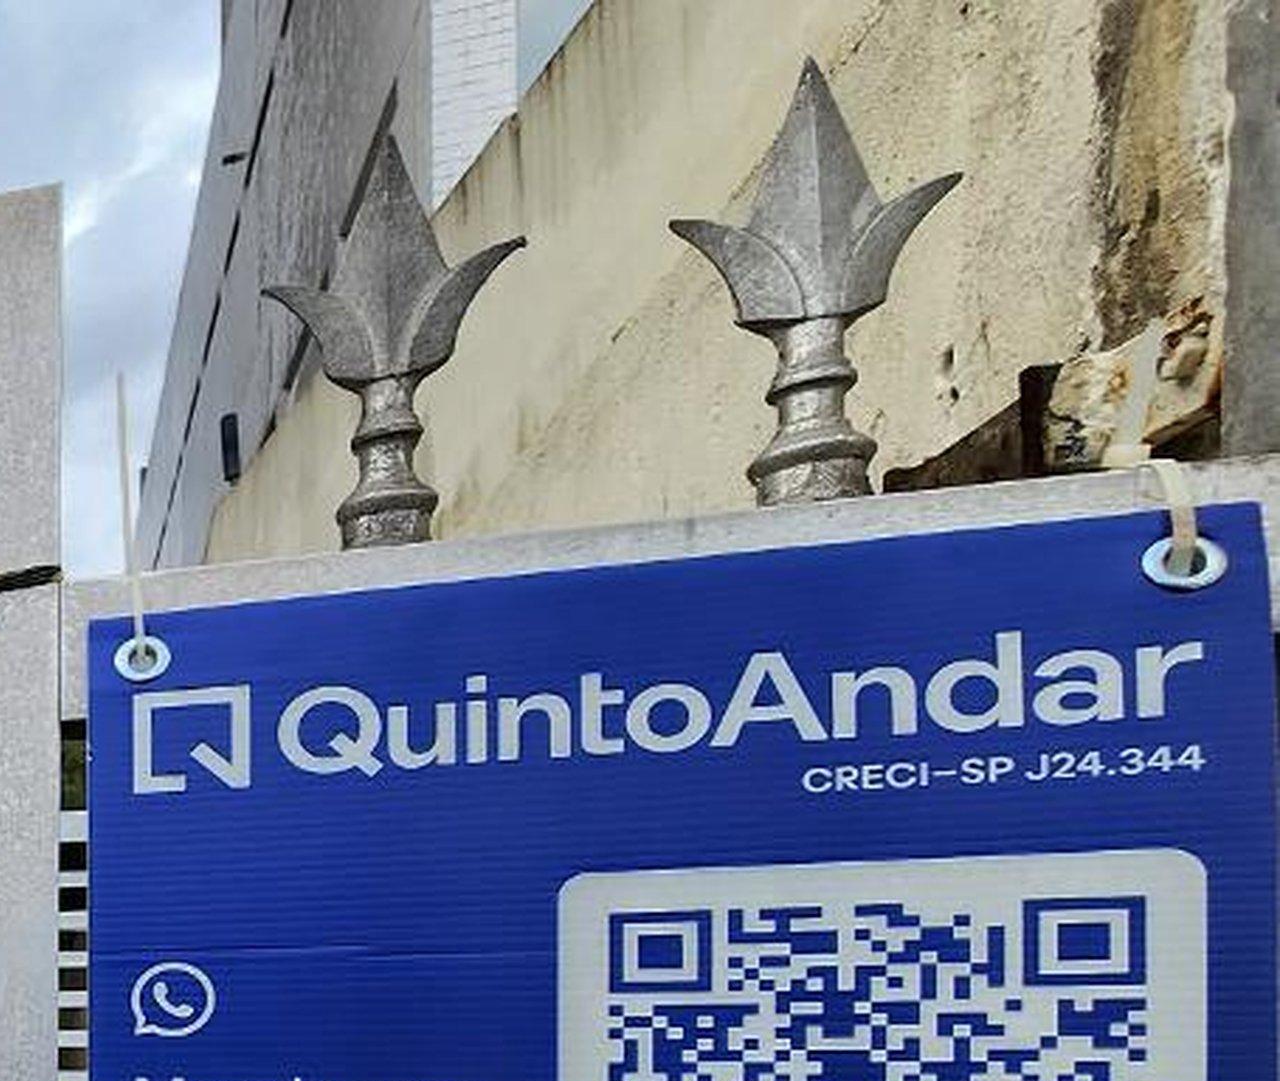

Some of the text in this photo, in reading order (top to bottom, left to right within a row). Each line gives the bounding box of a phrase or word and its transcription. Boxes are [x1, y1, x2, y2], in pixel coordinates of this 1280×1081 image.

[277, 630, 1204, 779] QuintoAndar
[801, 744, 1207, 794] CRECI-SP J24.344
